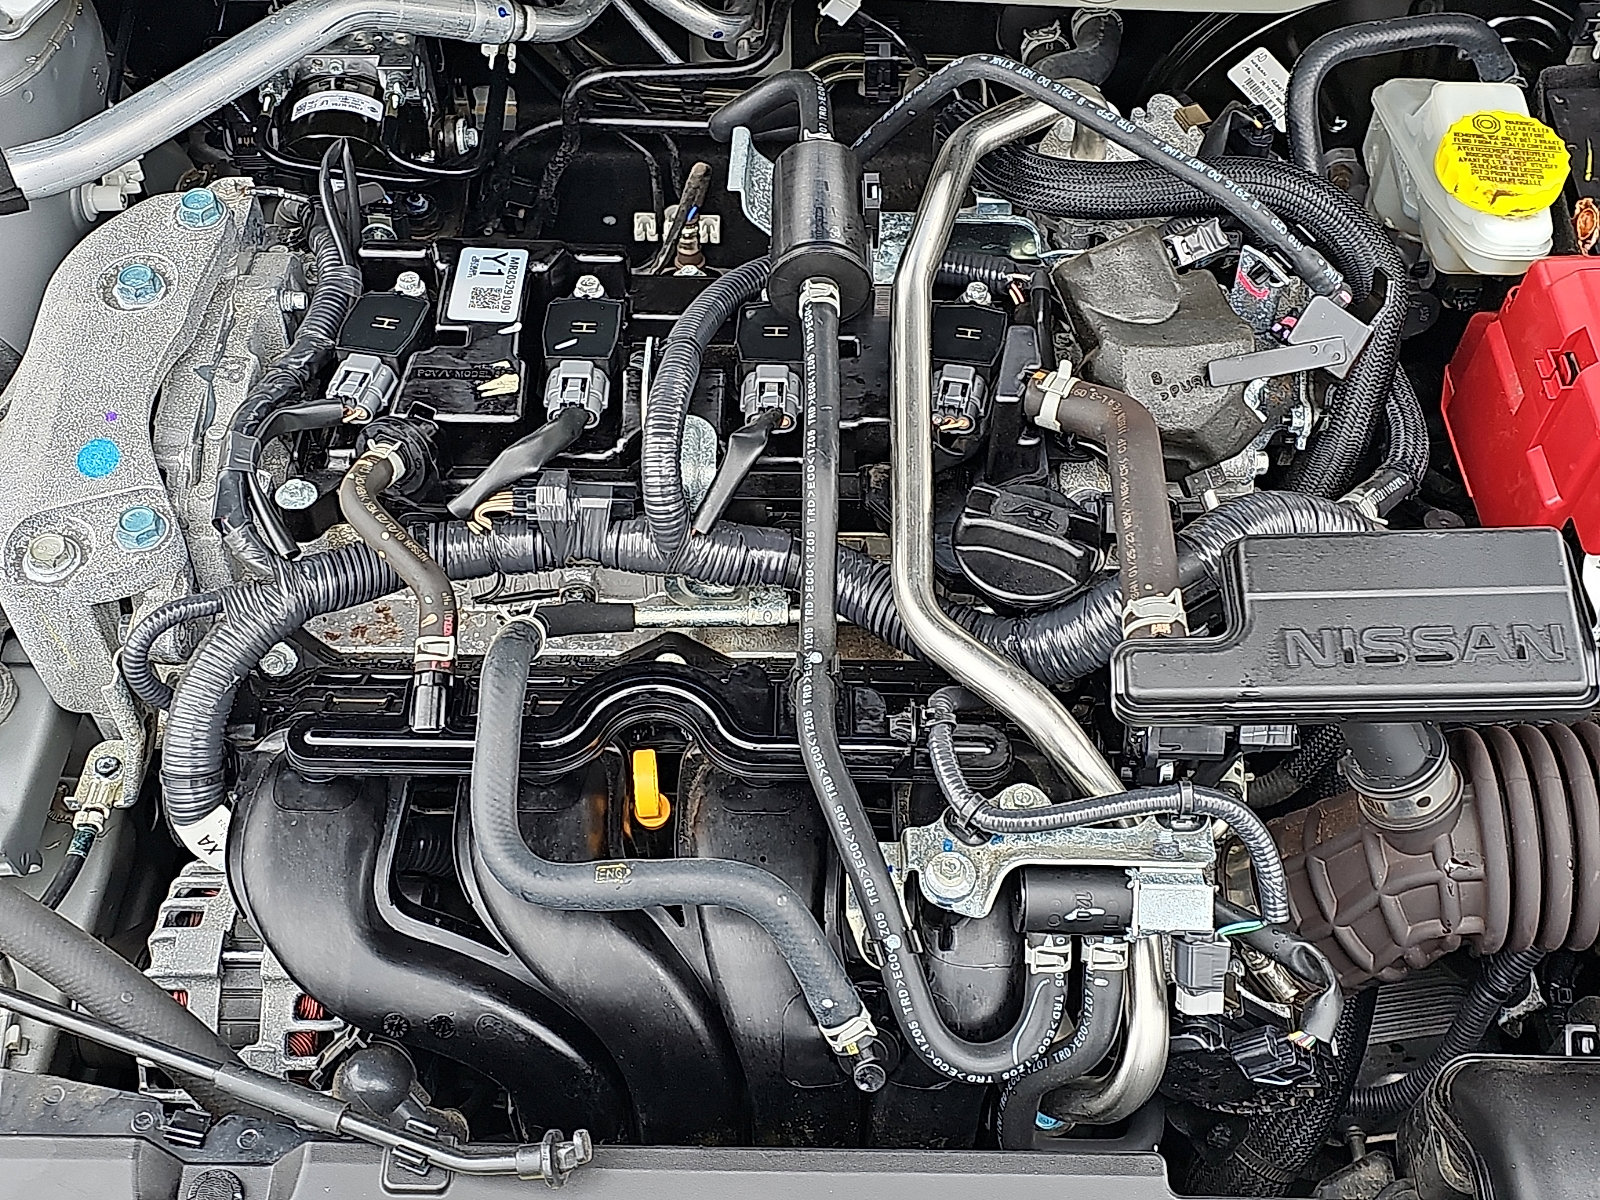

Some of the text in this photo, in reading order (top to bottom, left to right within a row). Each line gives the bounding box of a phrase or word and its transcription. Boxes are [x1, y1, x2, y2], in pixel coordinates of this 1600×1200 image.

[1036, 75, 1052, 88] DO
[1052, 83, 1077, 100] 2916
[1160, 143, 1187, 161] KINK
[1185, 158, 1207, 173] NOT
[1207, 169, 1223, 183] DO
[479, 252, 509, 276] Y1
[500, 256, 521, 314] MR20529109J
[1282, 625, 1567, 668] NISSAN
[197, 834, 224, 856] XA
